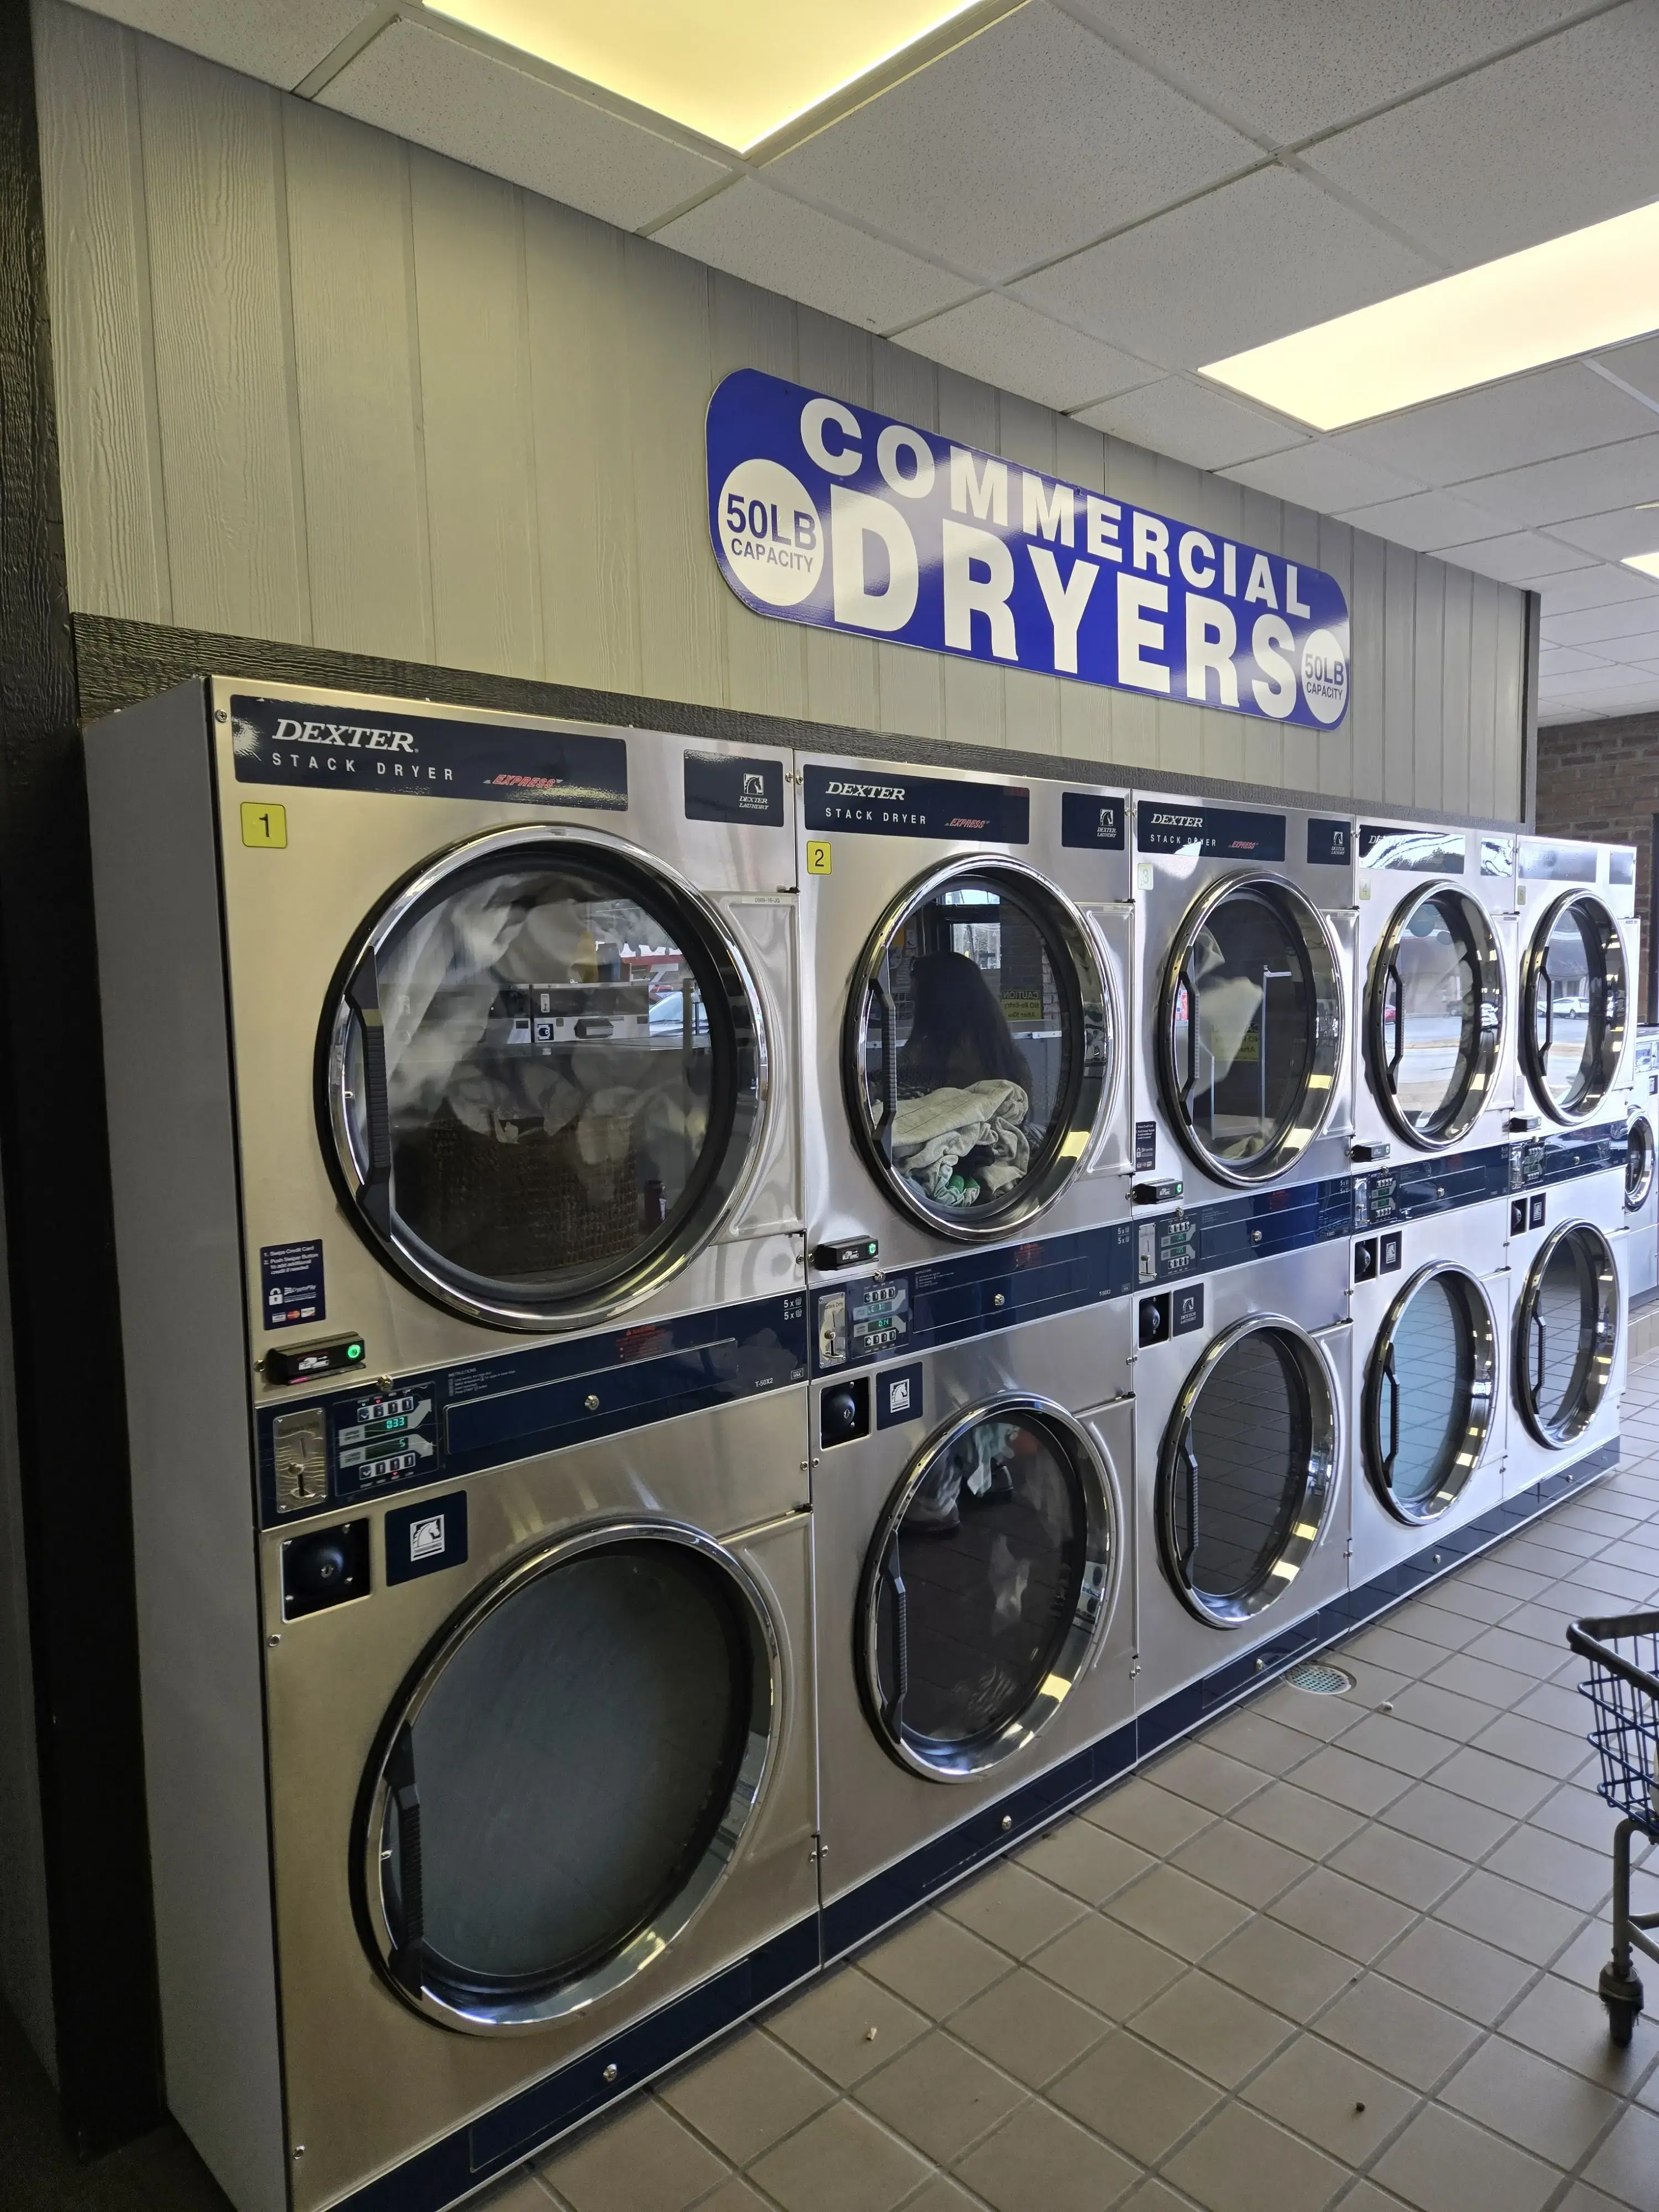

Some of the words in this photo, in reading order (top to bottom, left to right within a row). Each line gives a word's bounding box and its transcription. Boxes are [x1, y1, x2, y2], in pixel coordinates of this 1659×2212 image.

[801, 398, 1310, 619] COMMERCIAL
[727, 493, 816, 550] 50LB
[731, 538, 813, 573] CAPACITY
[830, 483, 1297, 719] DRYERS
[1305, 654, 1344, 686] 50LB
[1306, 682, 1343, 701] CAPACITY
[272, 719, 414, 753] DEXTER
[272, 753, 356, 772] STACK
[377, 762, 452, 780] DRYER
[492, 774, 556, 789] EXPRESS
[826, 781, 905, 800] DEXTER
[826, 807, 873, 820] STACK
[883, 812, 926, 824] DRYER
[950, 818, 985, 829] EXPRESS
[1151, 813, 1203, 827] DEXTER
[259, 813, 269, 837] 1
[1150, 834, 1181, 844] STACK
[1188, 837, 1216, 847] DRYER
[815, 849, 824, 867] 2
[1143, 870, 1149, 884] 3
[1363, 883, 1368, 895] 4
[784, 1300, 789, 1308] 5
[784, 1311, 789, 1320] 5
[1180, 1312, 1196, 1320] DEXTER
[755, 1377, 773, 1387] T-50X2
[399, 1438, 406, 1447] 5
